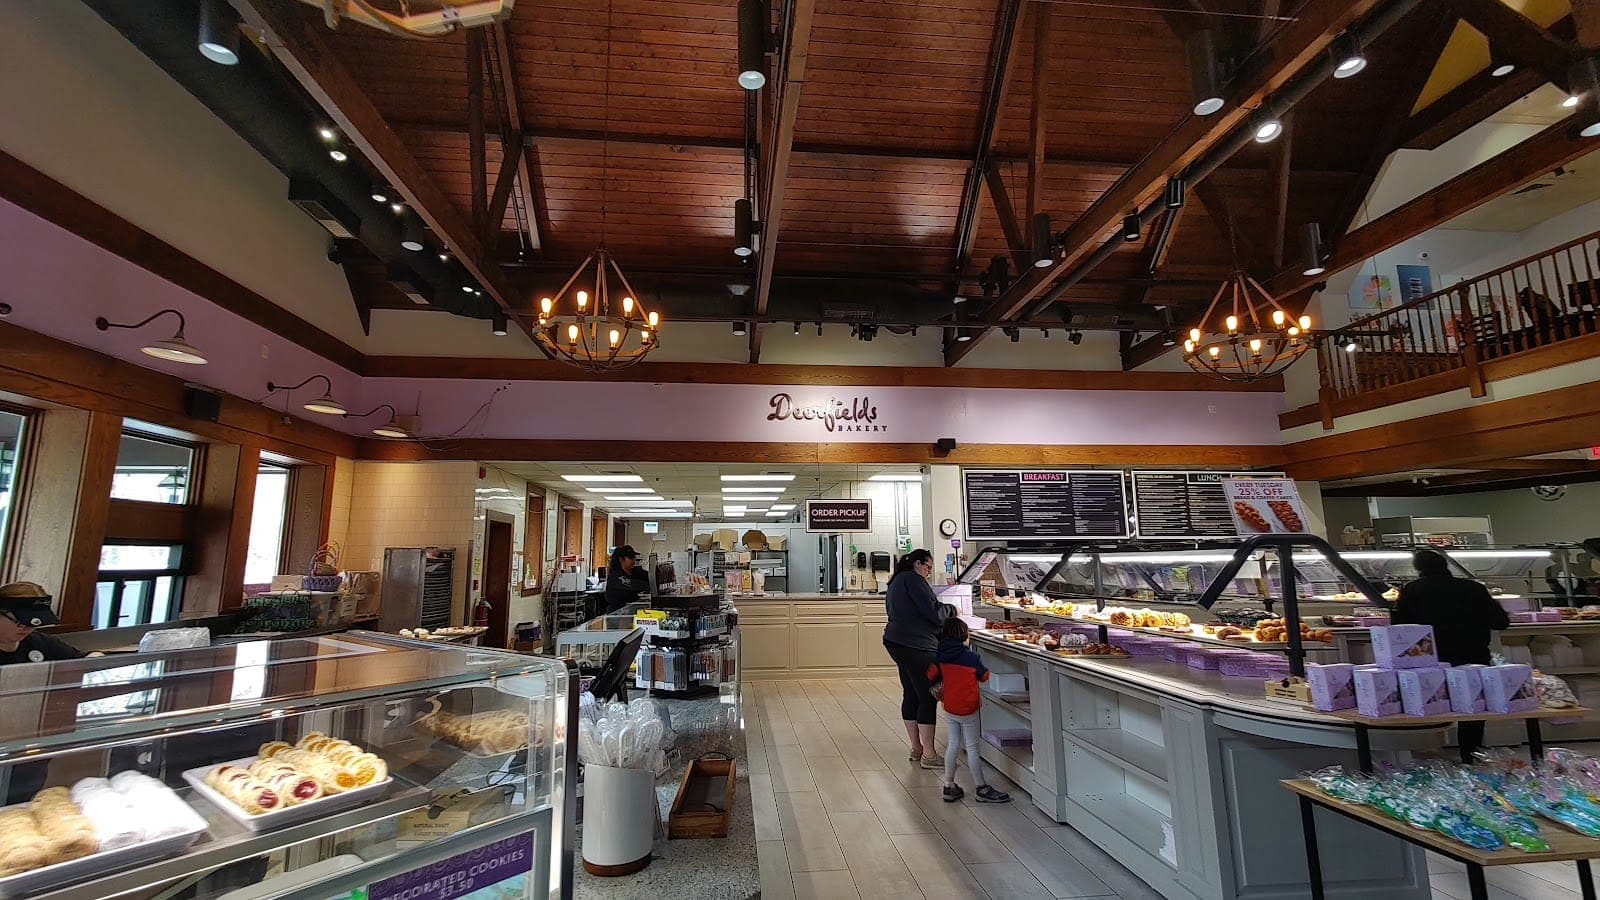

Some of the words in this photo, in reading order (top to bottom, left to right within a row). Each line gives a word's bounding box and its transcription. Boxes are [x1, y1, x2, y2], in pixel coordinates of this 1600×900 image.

[767, 393, 877, 432] Deerfields
[1023, 473, 1065, 481] BREAKFAST
[1197, 474, 1222, 482] LUNCH
[469, 849, 525, 877] COOKIES
[438, 878, 474, 899] $3.50
